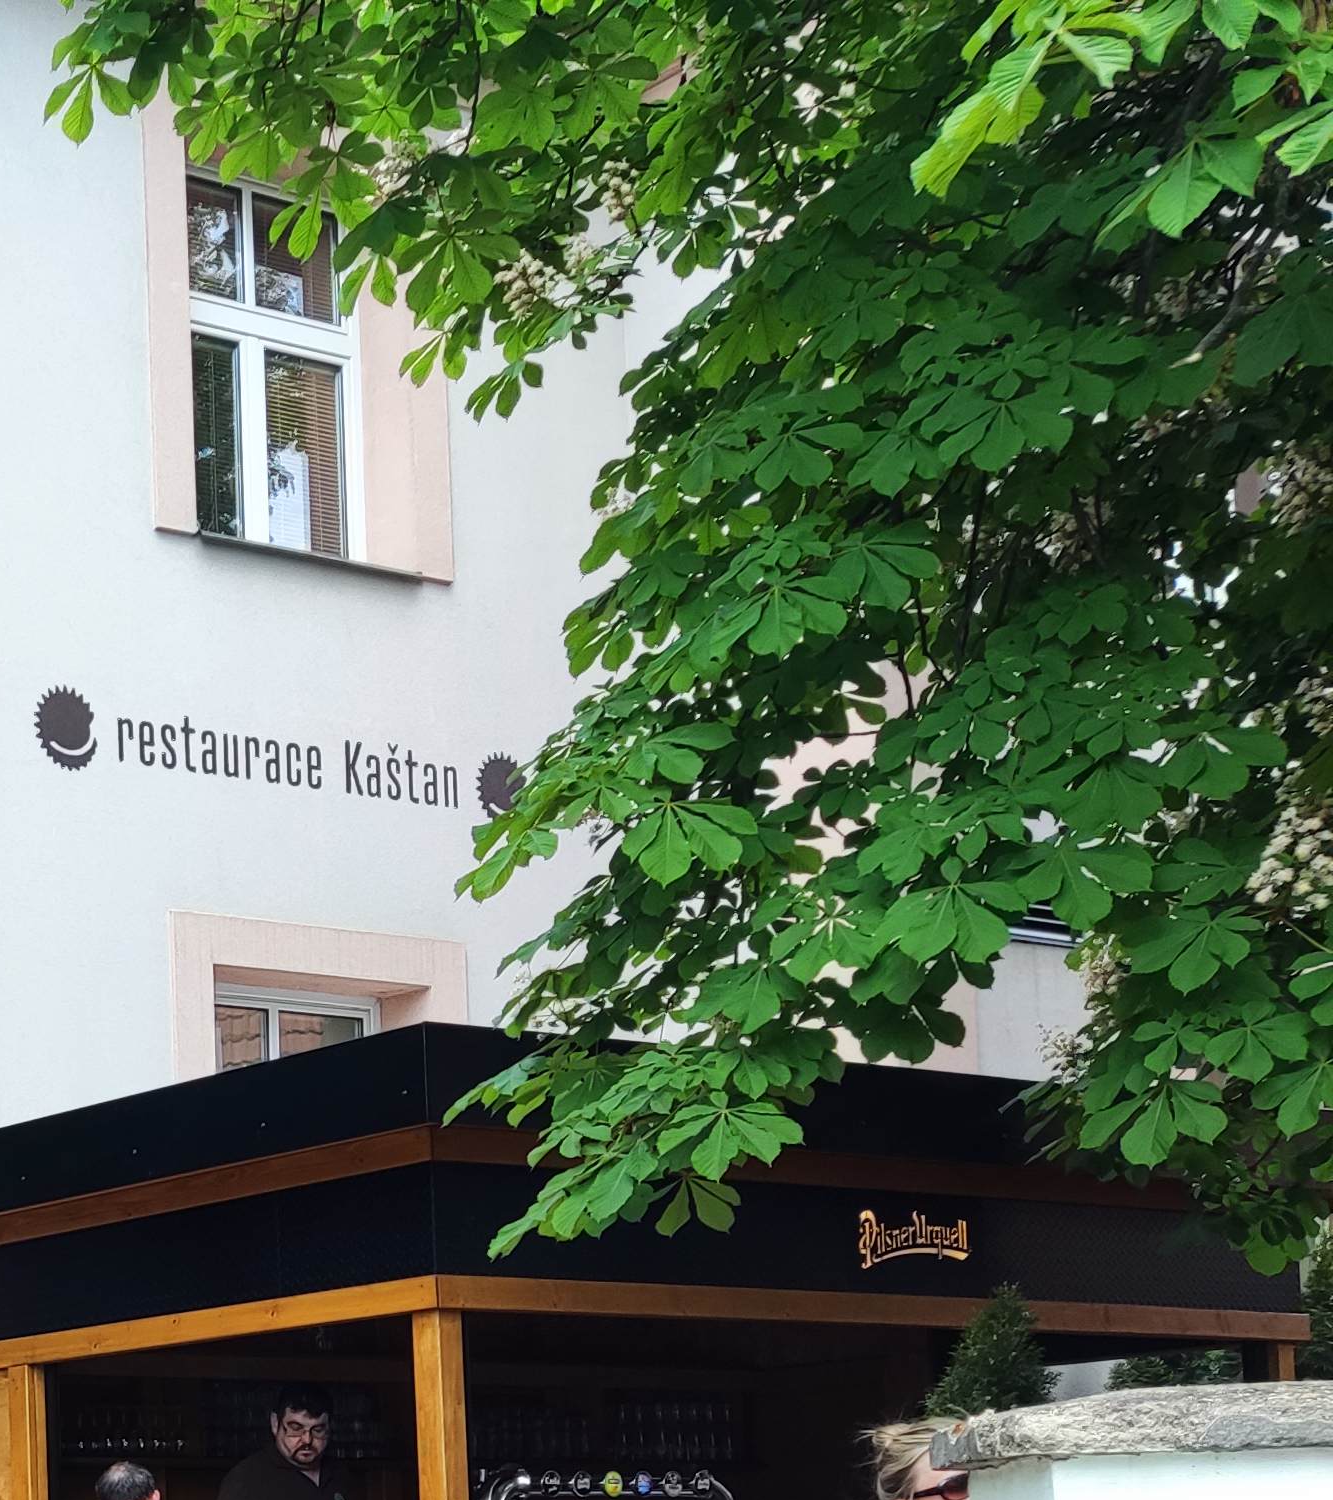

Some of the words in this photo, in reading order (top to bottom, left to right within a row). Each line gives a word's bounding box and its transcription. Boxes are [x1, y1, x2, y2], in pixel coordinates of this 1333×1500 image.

[116, 715, 323, 790] restaurace
[343, 739, 460, 809] Kaštan
[858, 1209, 915, 1270] Pilsner
[913, 1210, 968, 1260] Urquell
